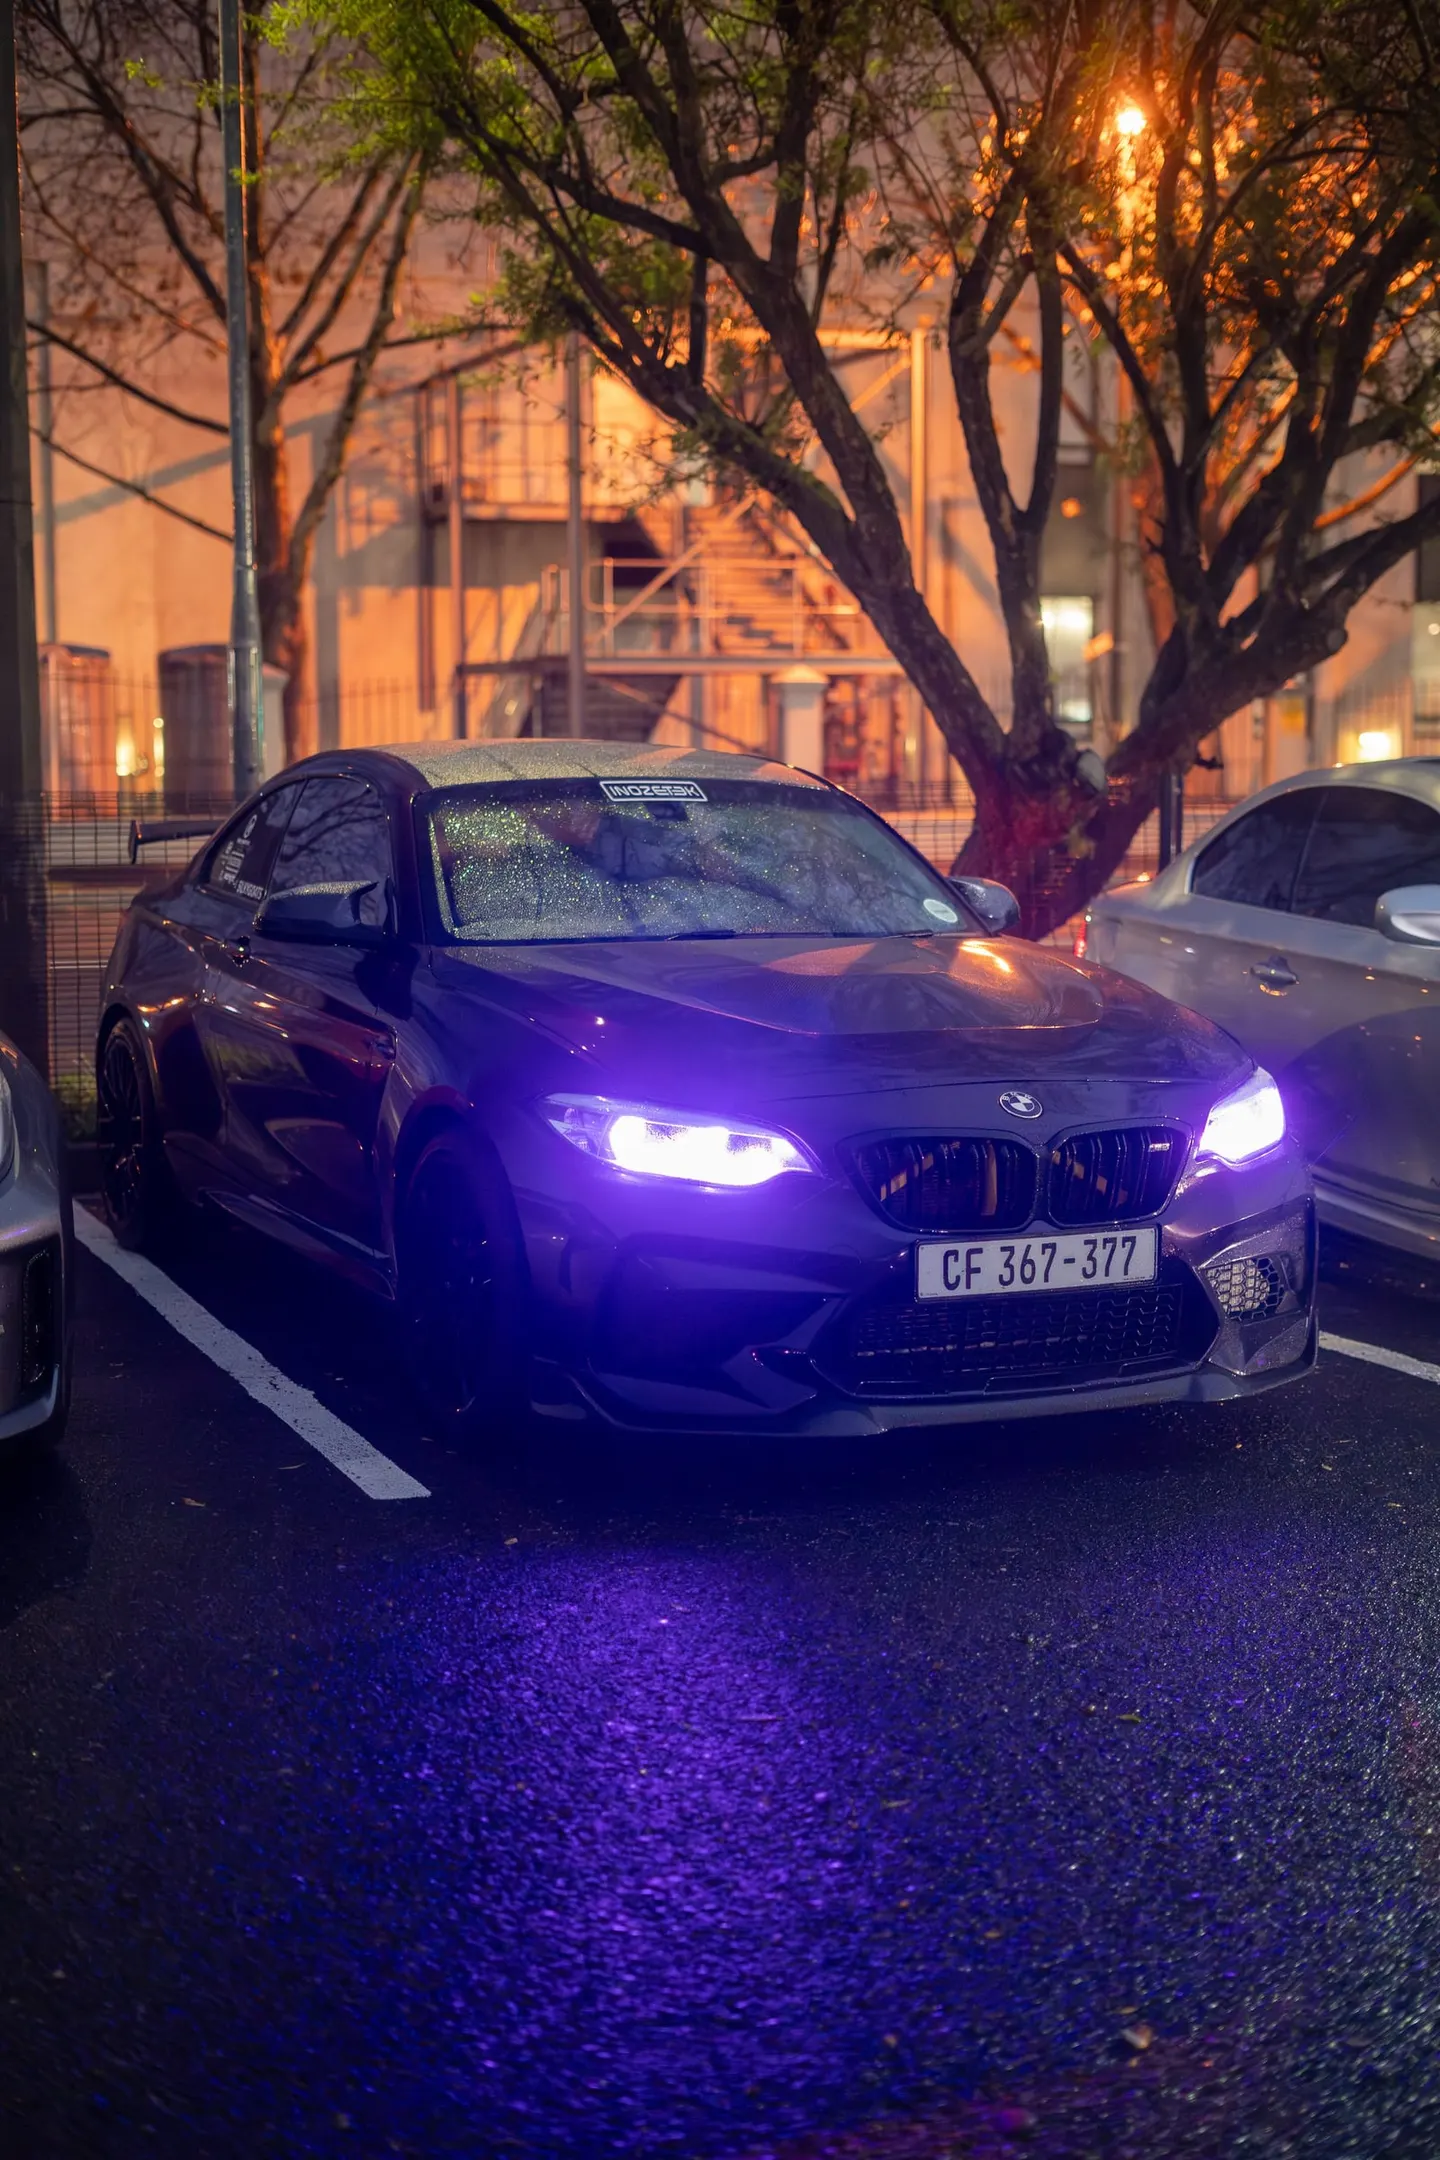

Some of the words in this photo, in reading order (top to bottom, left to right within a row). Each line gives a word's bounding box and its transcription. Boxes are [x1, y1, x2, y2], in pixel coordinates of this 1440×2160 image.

[609, 785, 700, 797] INOZETEK
[942, 1248, 984, 1291] CF
[998, 1236, 1137, 1286] 367-377
